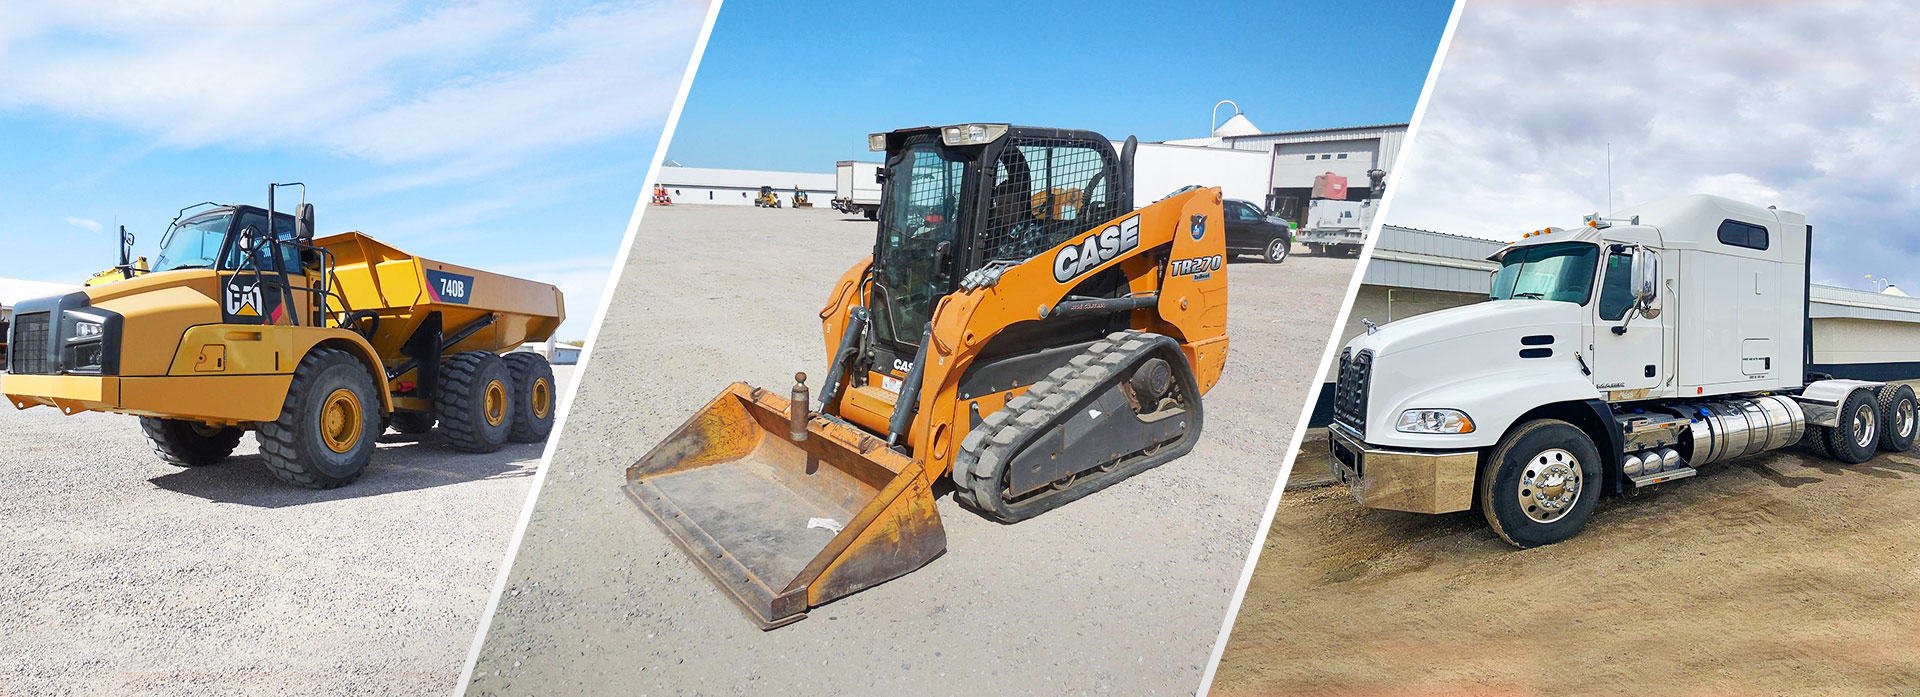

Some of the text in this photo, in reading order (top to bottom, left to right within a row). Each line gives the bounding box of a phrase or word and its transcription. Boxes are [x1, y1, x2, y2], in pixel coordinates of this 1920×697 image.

[1054, 213, 1140, 283] CASE
[1171, 254, 1222, 277] TR270
[440, 278, 464, 298] 740B
[226, 283, 263, 317] CAT
[893, 358, 914, 373] CAS
